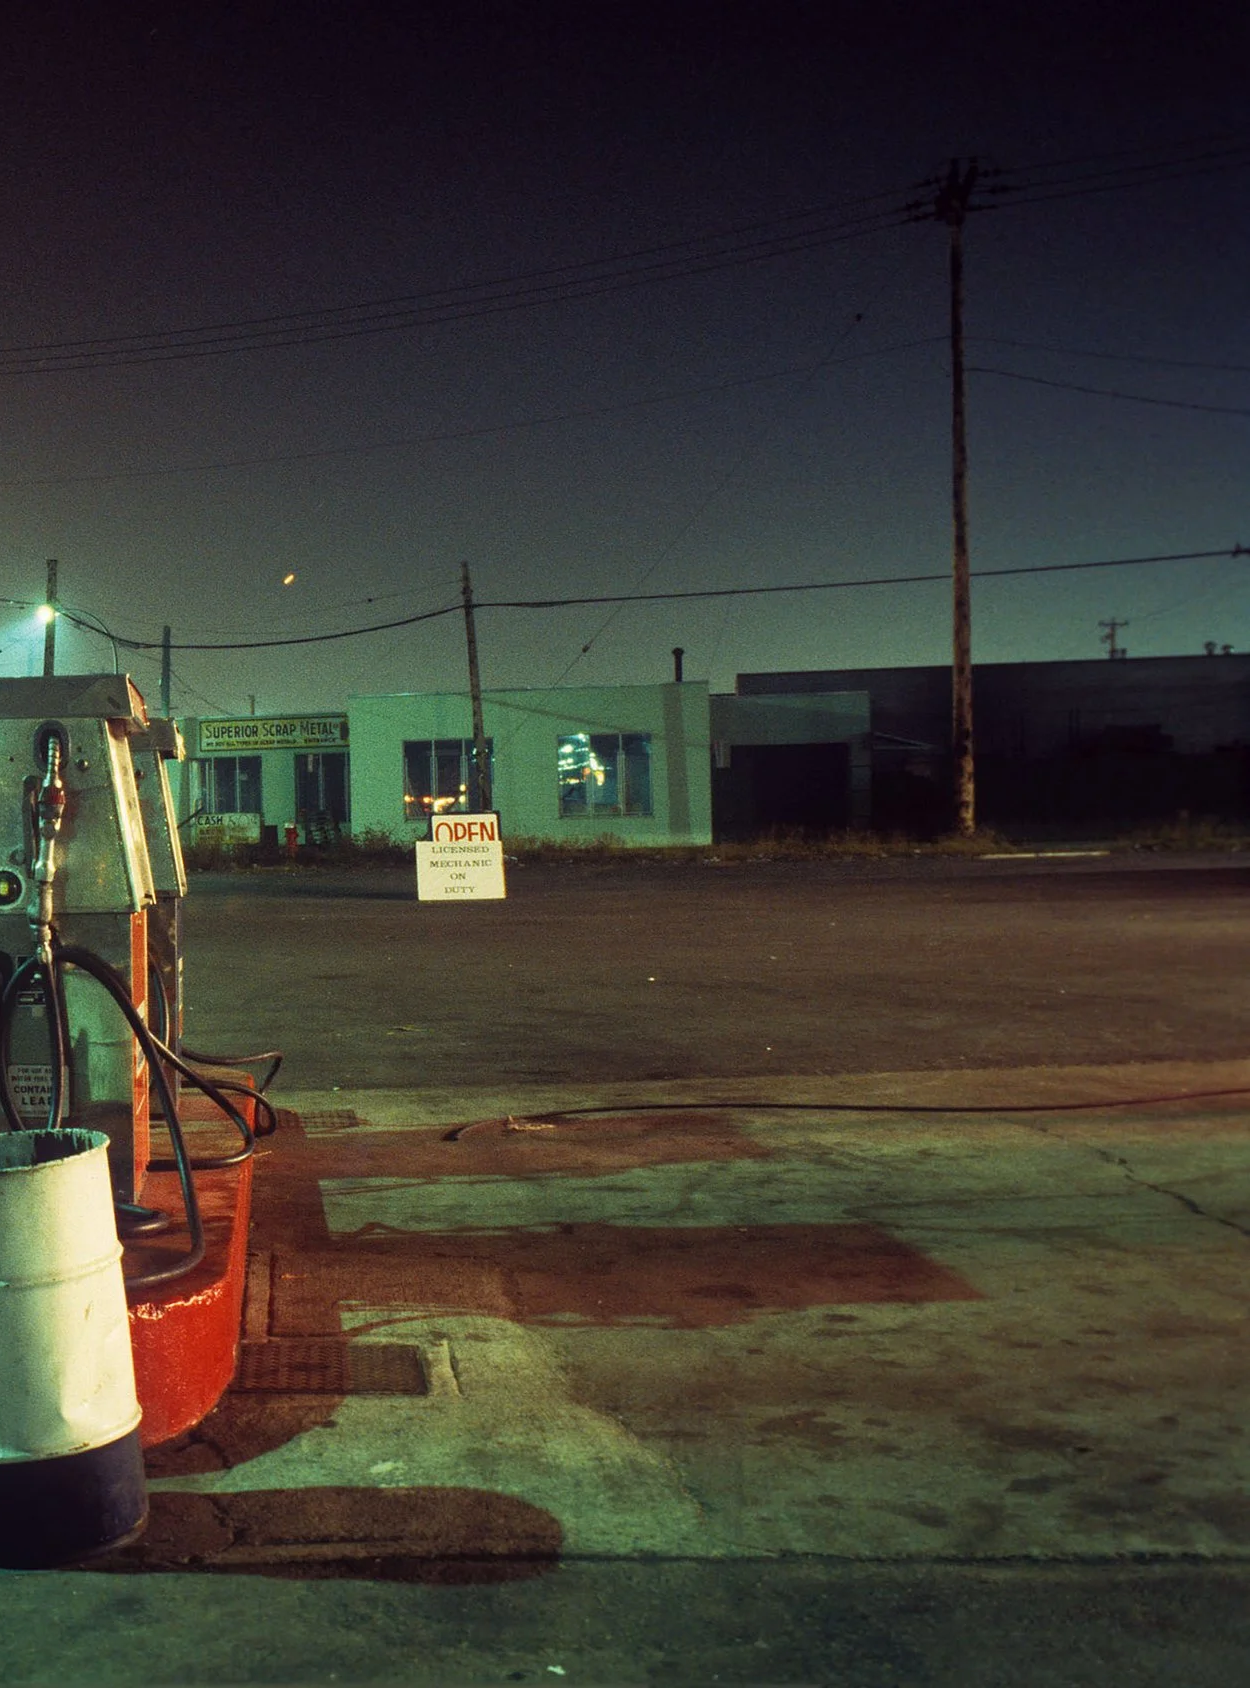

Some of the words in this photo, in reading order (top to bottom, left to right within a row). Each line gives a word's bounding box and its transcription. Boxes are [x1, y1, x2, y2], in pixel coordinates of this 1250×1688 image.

[205, 724, 258, 739] SUPERIOR
[262, 722, 297, 737] SCRAP
[300, 720, 335, 736] METAL
[197, 815, 223, 826] CASH
[434, 821, 495, 842] OPEN
[432, 846, 489, 854] LICENSED
[430, 859, 492, 868] MECHANIC
[14, 1085, 52, 1094] CONTAI
